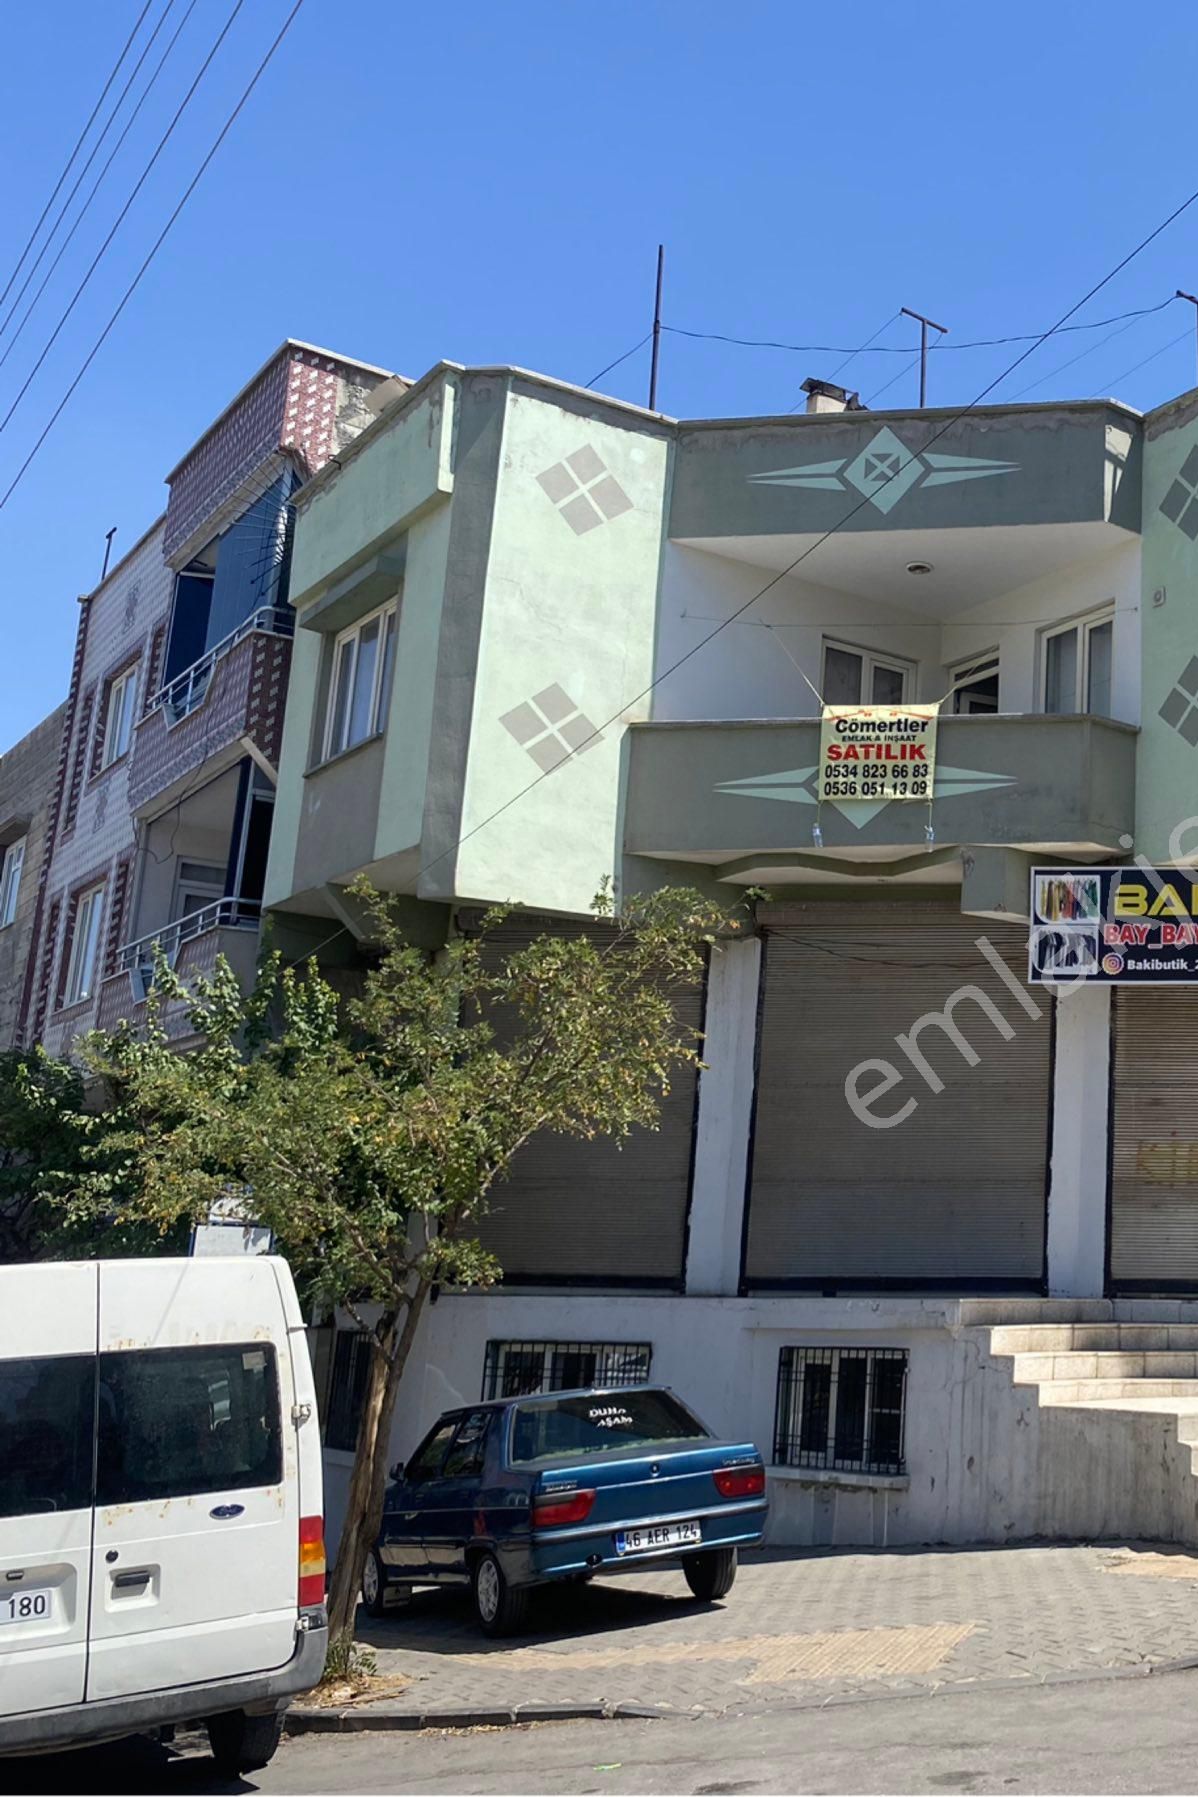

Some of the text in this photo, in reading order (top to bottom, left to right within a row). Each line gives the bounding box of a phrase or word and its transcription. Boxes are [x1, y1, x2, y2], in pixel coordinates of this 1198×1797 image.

[835, 718, 928, 733] Cömertler
[827, 744, 926, 761] SATILIK
[825, 764, 928, 778] 0534 823 66 83
[824, 781, 927, 795] 0536 051 13 09
[626, 1523, 697, 1548] 46 AER 124
[8, 1595, 46, 1619] 180
